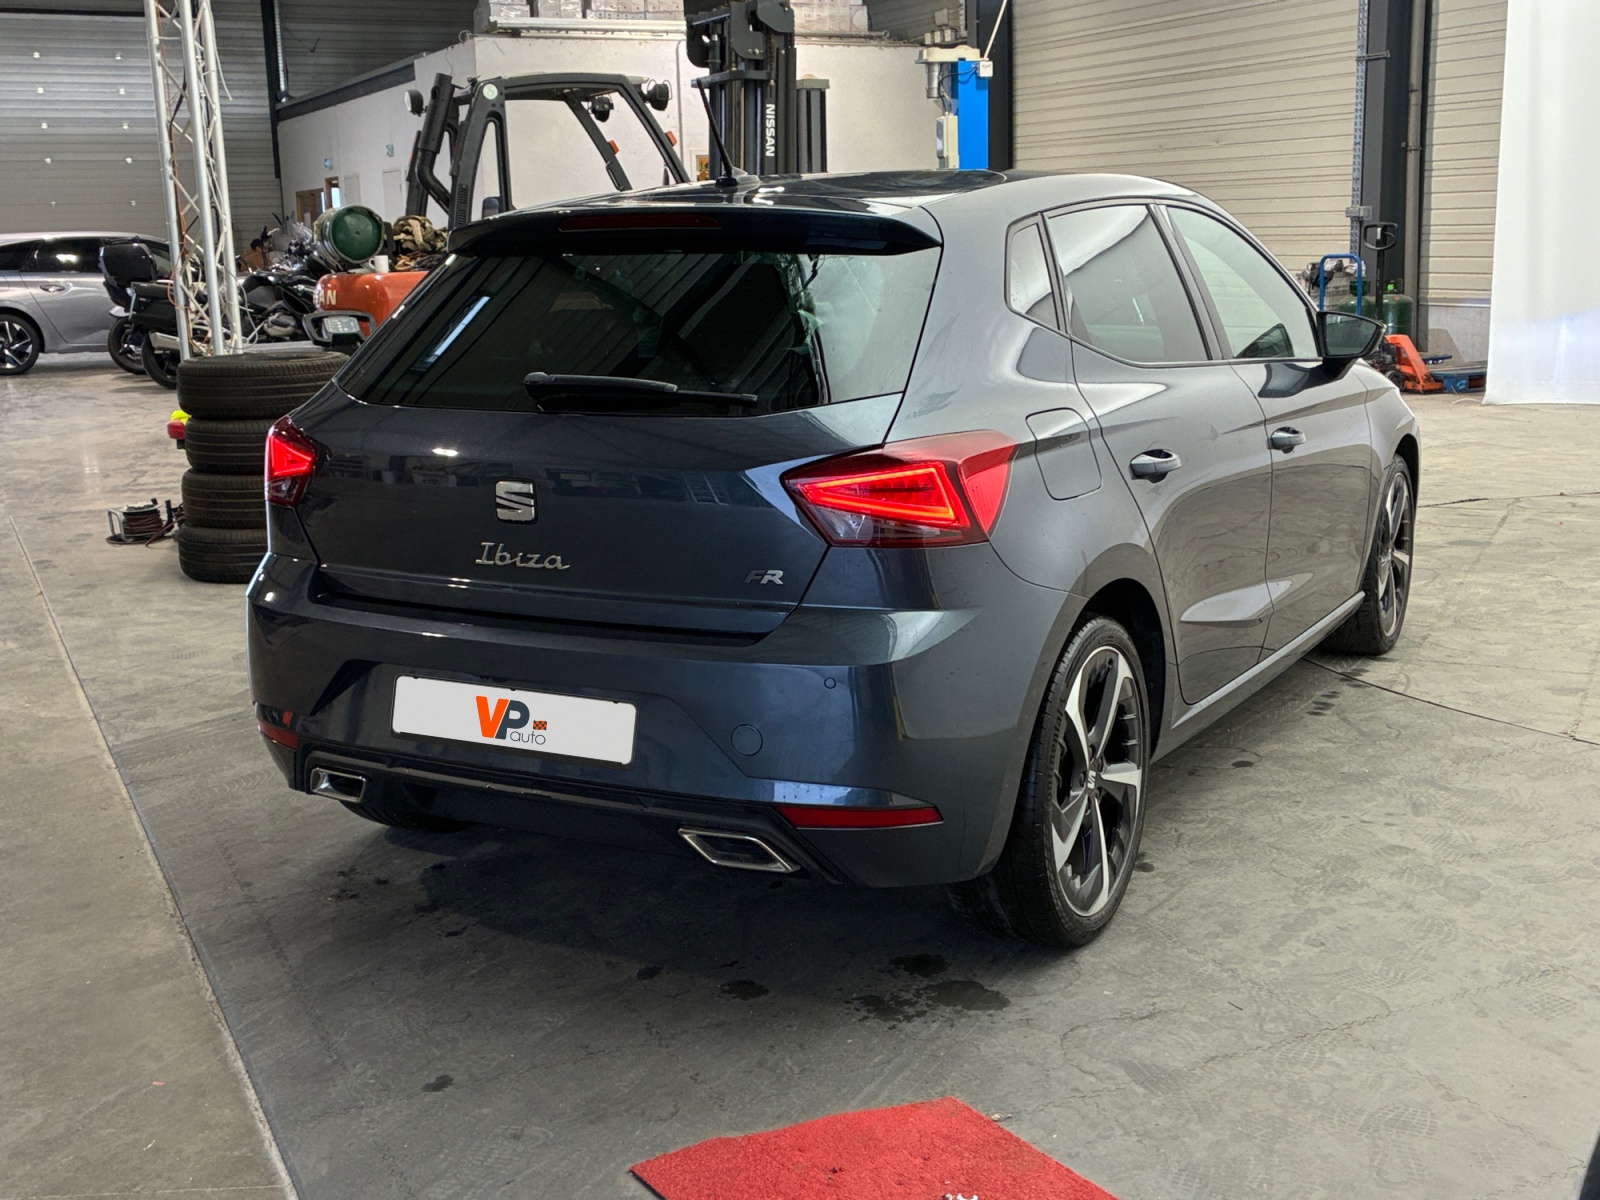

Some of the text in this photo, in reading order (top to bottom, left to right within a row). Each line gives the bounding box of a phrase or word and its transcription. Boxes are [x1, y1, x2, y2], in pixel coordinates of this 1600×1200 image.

[765, 103, 775, 157] NISSAN
[475, 542, 570, 570] Ibiza
[744, 569, 784, 585] FR
[475, 695, 530, 740] VP
[509, 730, 546, 745] auto
